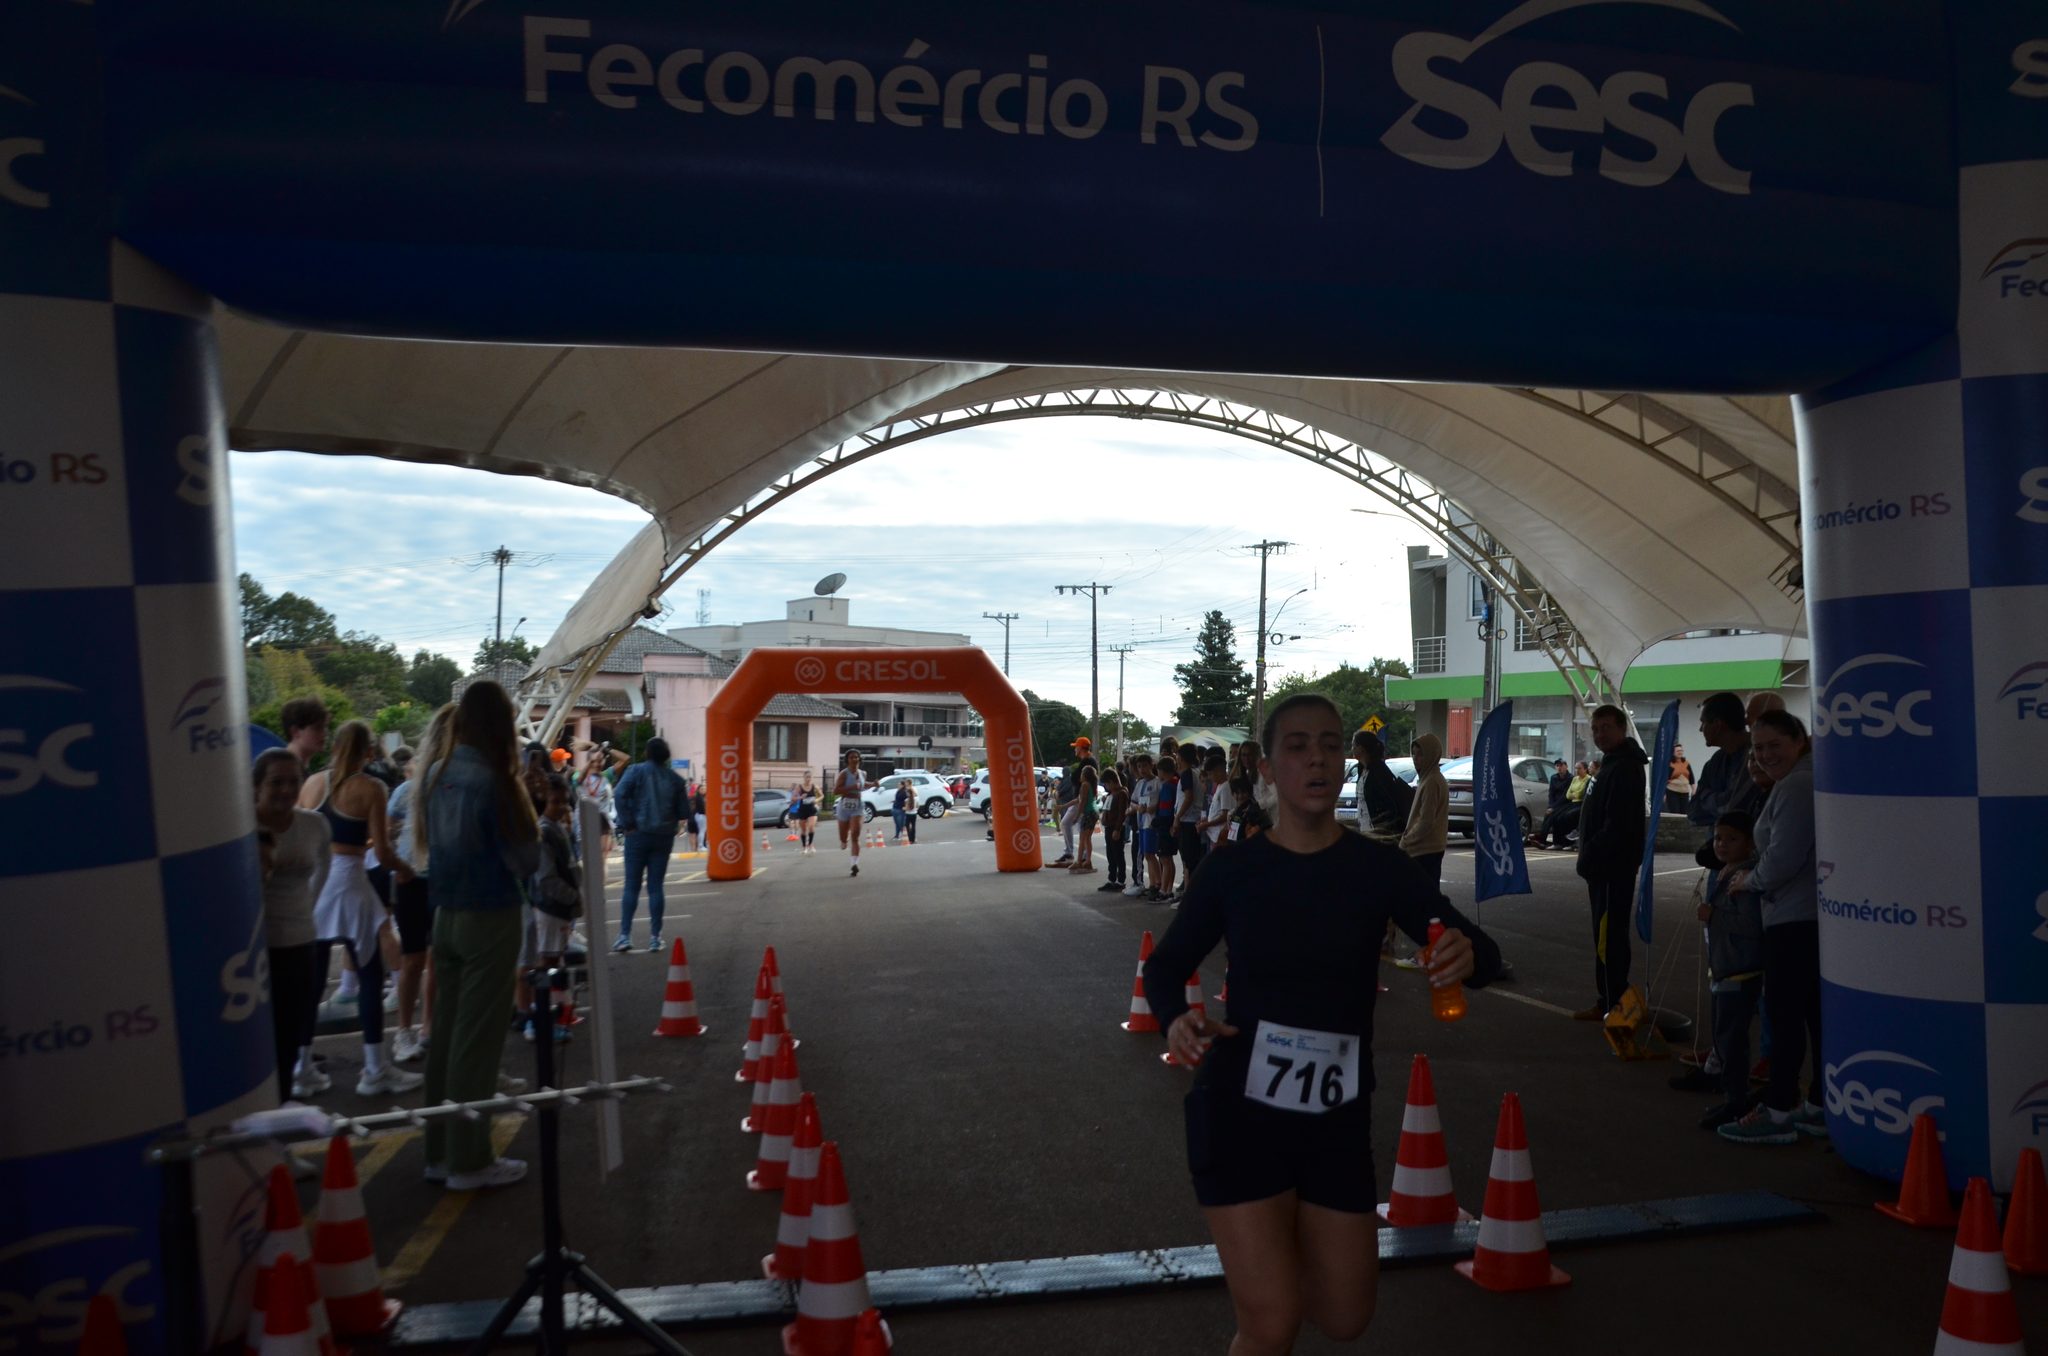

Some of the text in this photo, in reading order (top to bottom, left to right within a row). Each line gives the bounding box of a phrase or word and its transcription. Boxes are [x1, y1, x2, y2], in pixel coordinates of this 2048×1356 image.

[523, 16, 1260, 152] Fecomércio RS
[50, 452, 109, 485] RS
[1909, 493, 1952, 517] RS
[835, 659, 946, 682] CRESOL
[720, 737, 740, 832] CRESOL
[1006, 730, 1031, 823] CRESOL
[1926, 905, 1968, 929] RS
[105, 1004, 160, 1041] RS
[1265, 1054, 1344, 1107] 716
